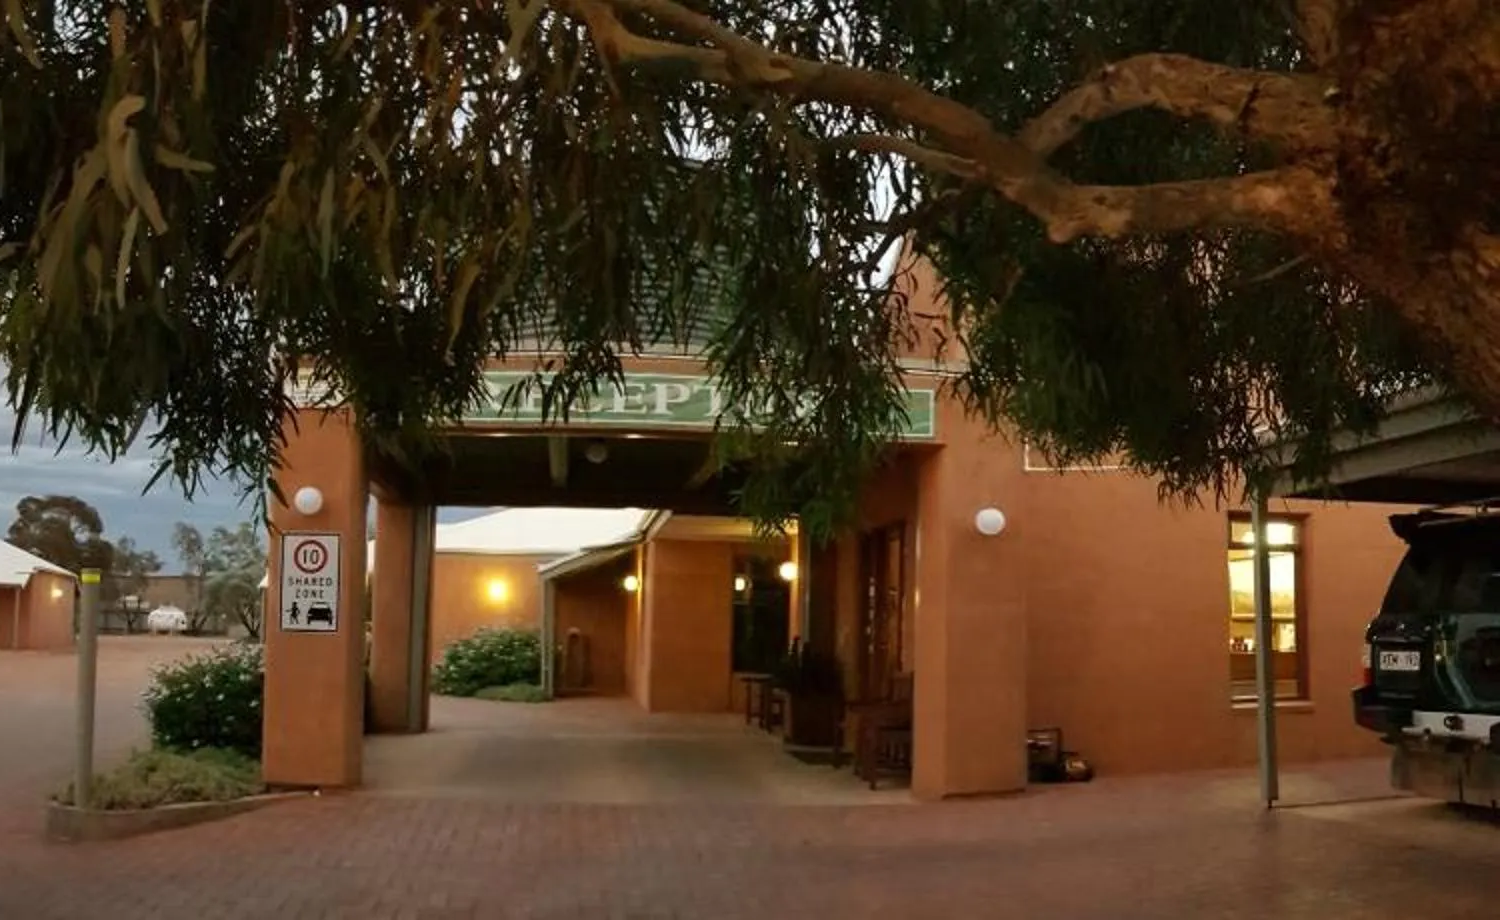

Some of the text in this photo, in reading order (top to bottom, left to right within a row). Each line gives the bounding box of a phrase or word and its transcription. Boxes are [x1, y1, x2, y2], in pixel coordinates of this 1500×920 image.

[303, 549, 319, 564] 10
[287, 576, 333, 587] SHARED
[295, 588, 325, 599] ZONE
